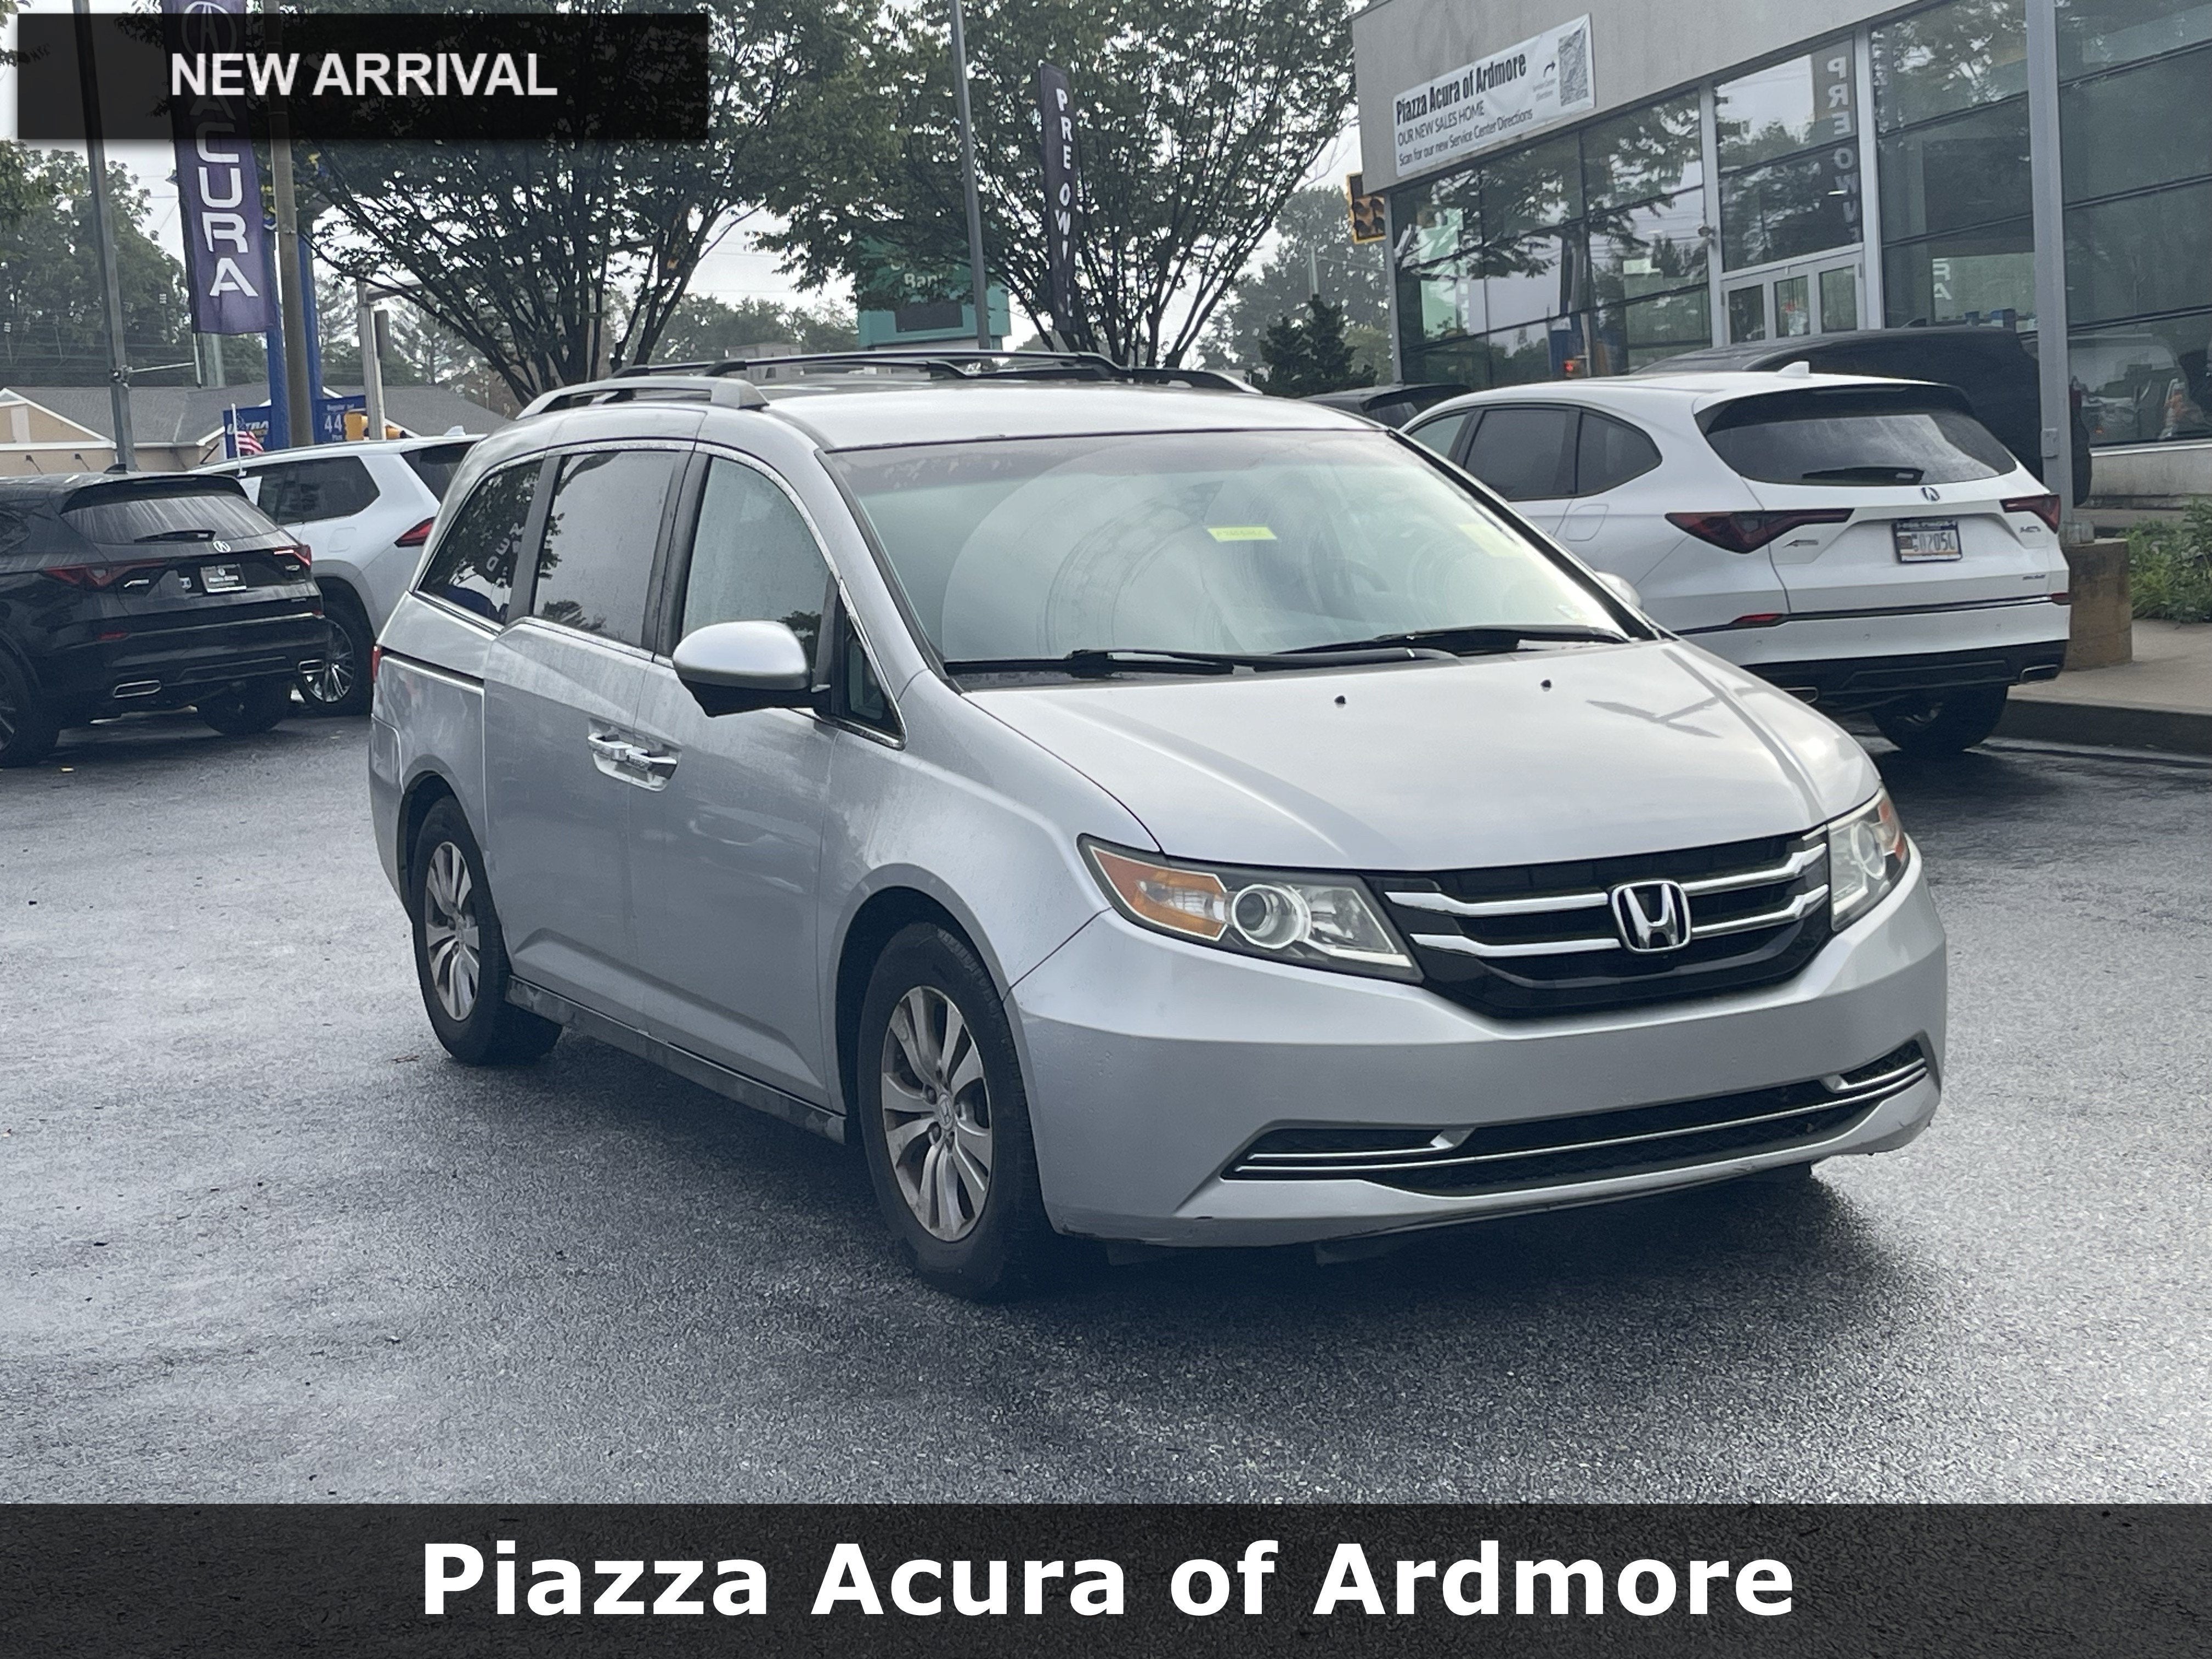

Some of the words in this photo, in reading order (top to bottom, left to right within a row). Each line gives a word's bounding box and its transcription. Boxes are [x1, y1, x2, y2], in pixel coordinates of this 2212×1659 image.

[1396, 94, 1427, 126] Piazza
[1430, 81, 1460, 112] Acura
[1463, 69, 1474, 99] of
[1476, 54, 1526, 94] Ardmore
[1057, 88, 1073, 169] PRE
[1398, 128, 1414, 146] OUR
[1415, 120, 1434, 140] NEW
[1435, 111, 1457, 133] SALES
[1459, 100, 1485, 124] HOME
[1399, 153, 1413, 166] Scan
[1413, 148, 1423, 160] for
[1424, 145, 1434, 157] our
[1435, 140, 1448, 153] new
[1449, 129, 1472, 148] Service
[1474, 122, 1497, 139] Center
[1497, 109, 1533, 131] Directions
[905, 273, 945, 289] Ban
